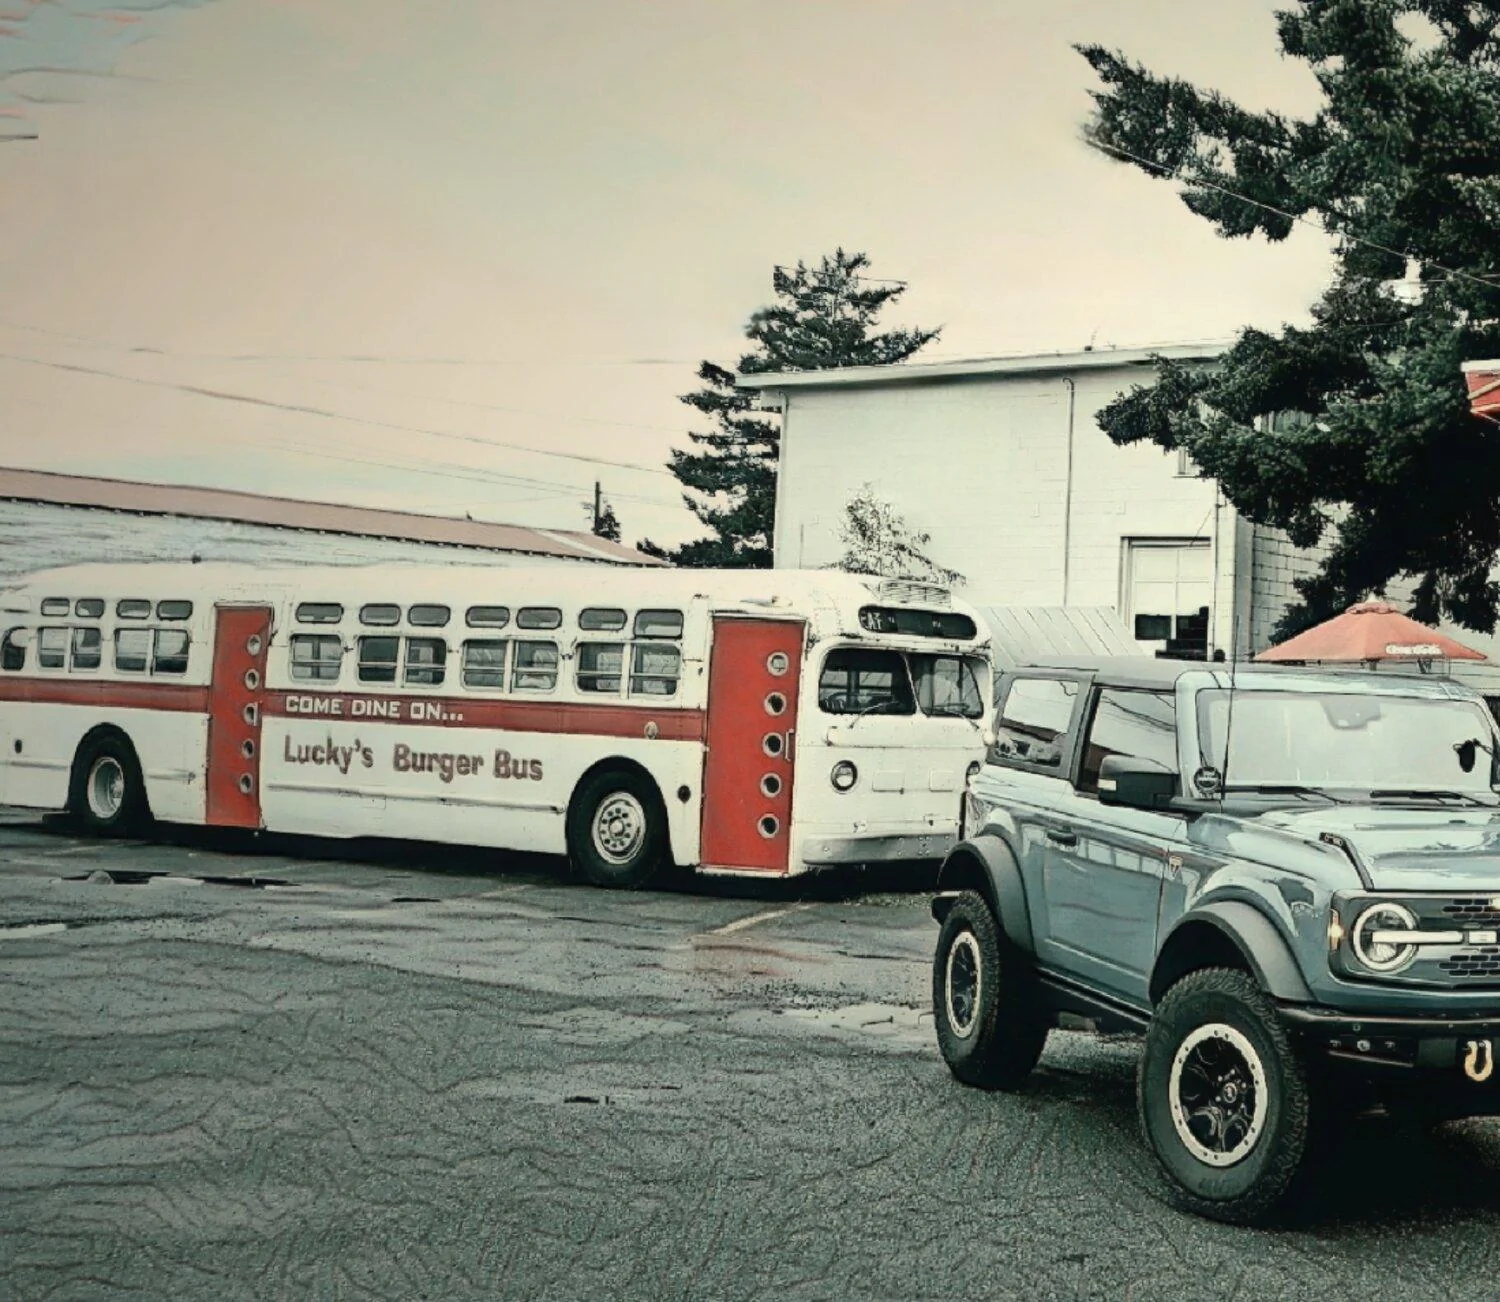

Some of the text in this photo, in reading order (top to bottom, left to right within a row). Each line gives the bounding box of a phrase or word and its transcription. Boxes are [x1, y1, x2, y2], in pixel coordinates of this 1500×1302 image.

[284, 695, 464, 721] COME DINE ON...
[284, 733, 544, 783] Lucky's Burger Bus
